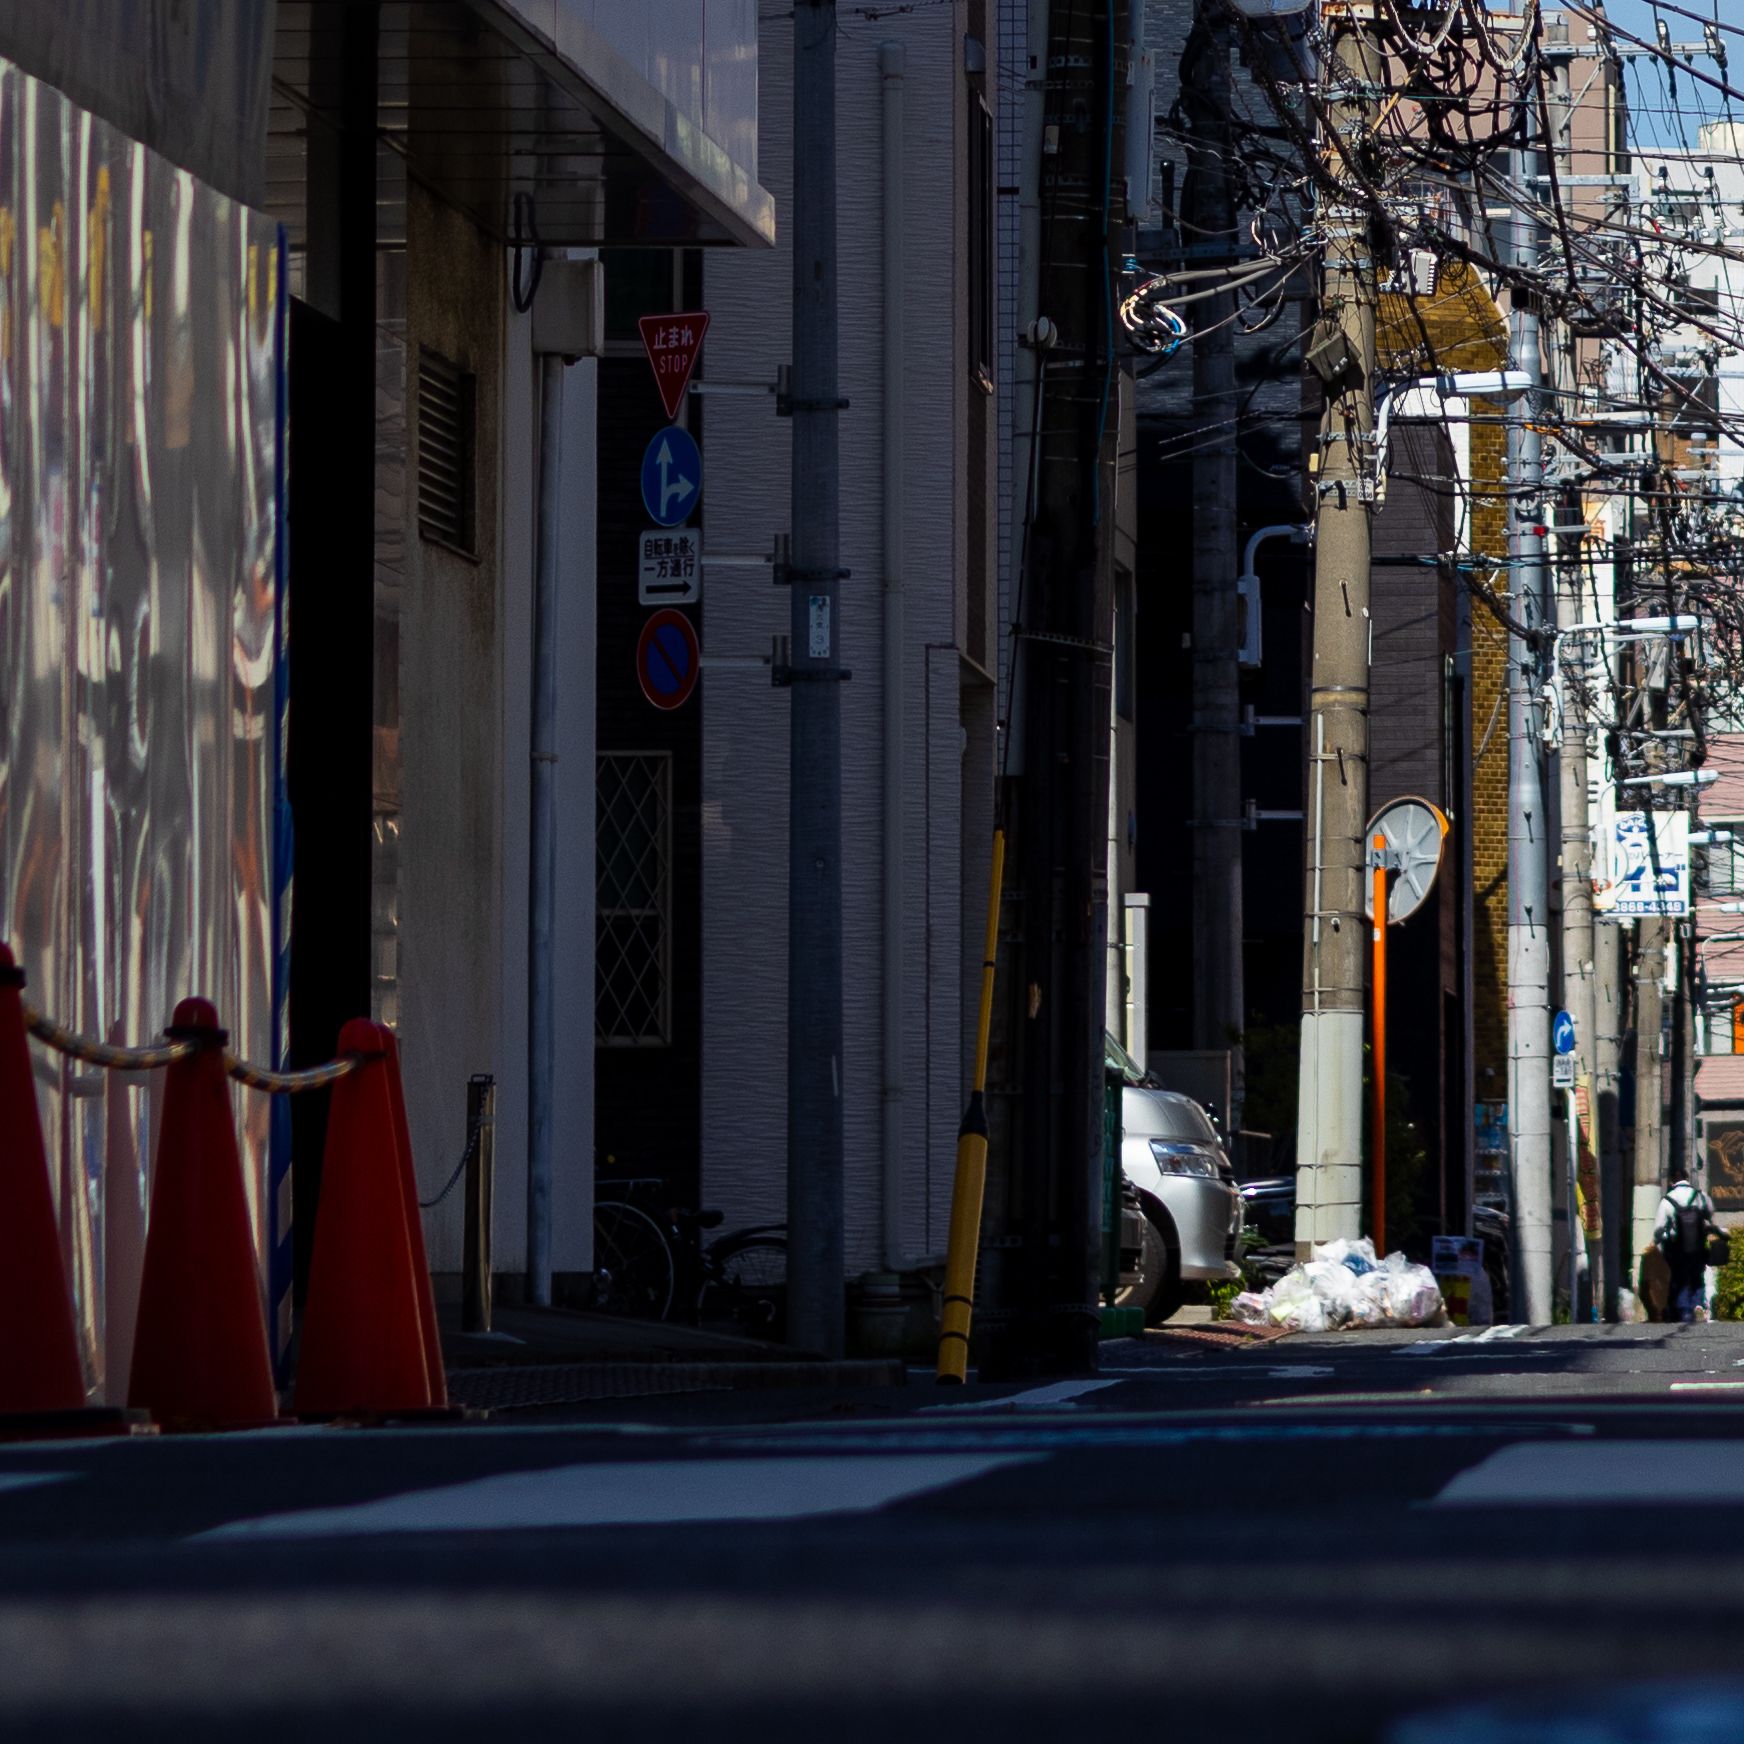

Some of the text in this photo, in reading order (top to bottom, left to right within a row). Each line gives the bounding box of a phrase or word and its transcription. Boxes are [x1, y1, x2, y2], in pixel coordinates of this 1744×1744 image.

[652, 325, 694, 351] 止まれ
[658, 353, 688, 375] STOP
[643, 536, 695, 558] 自転車を除く
[643, 558, 695, 578] 一方通行
